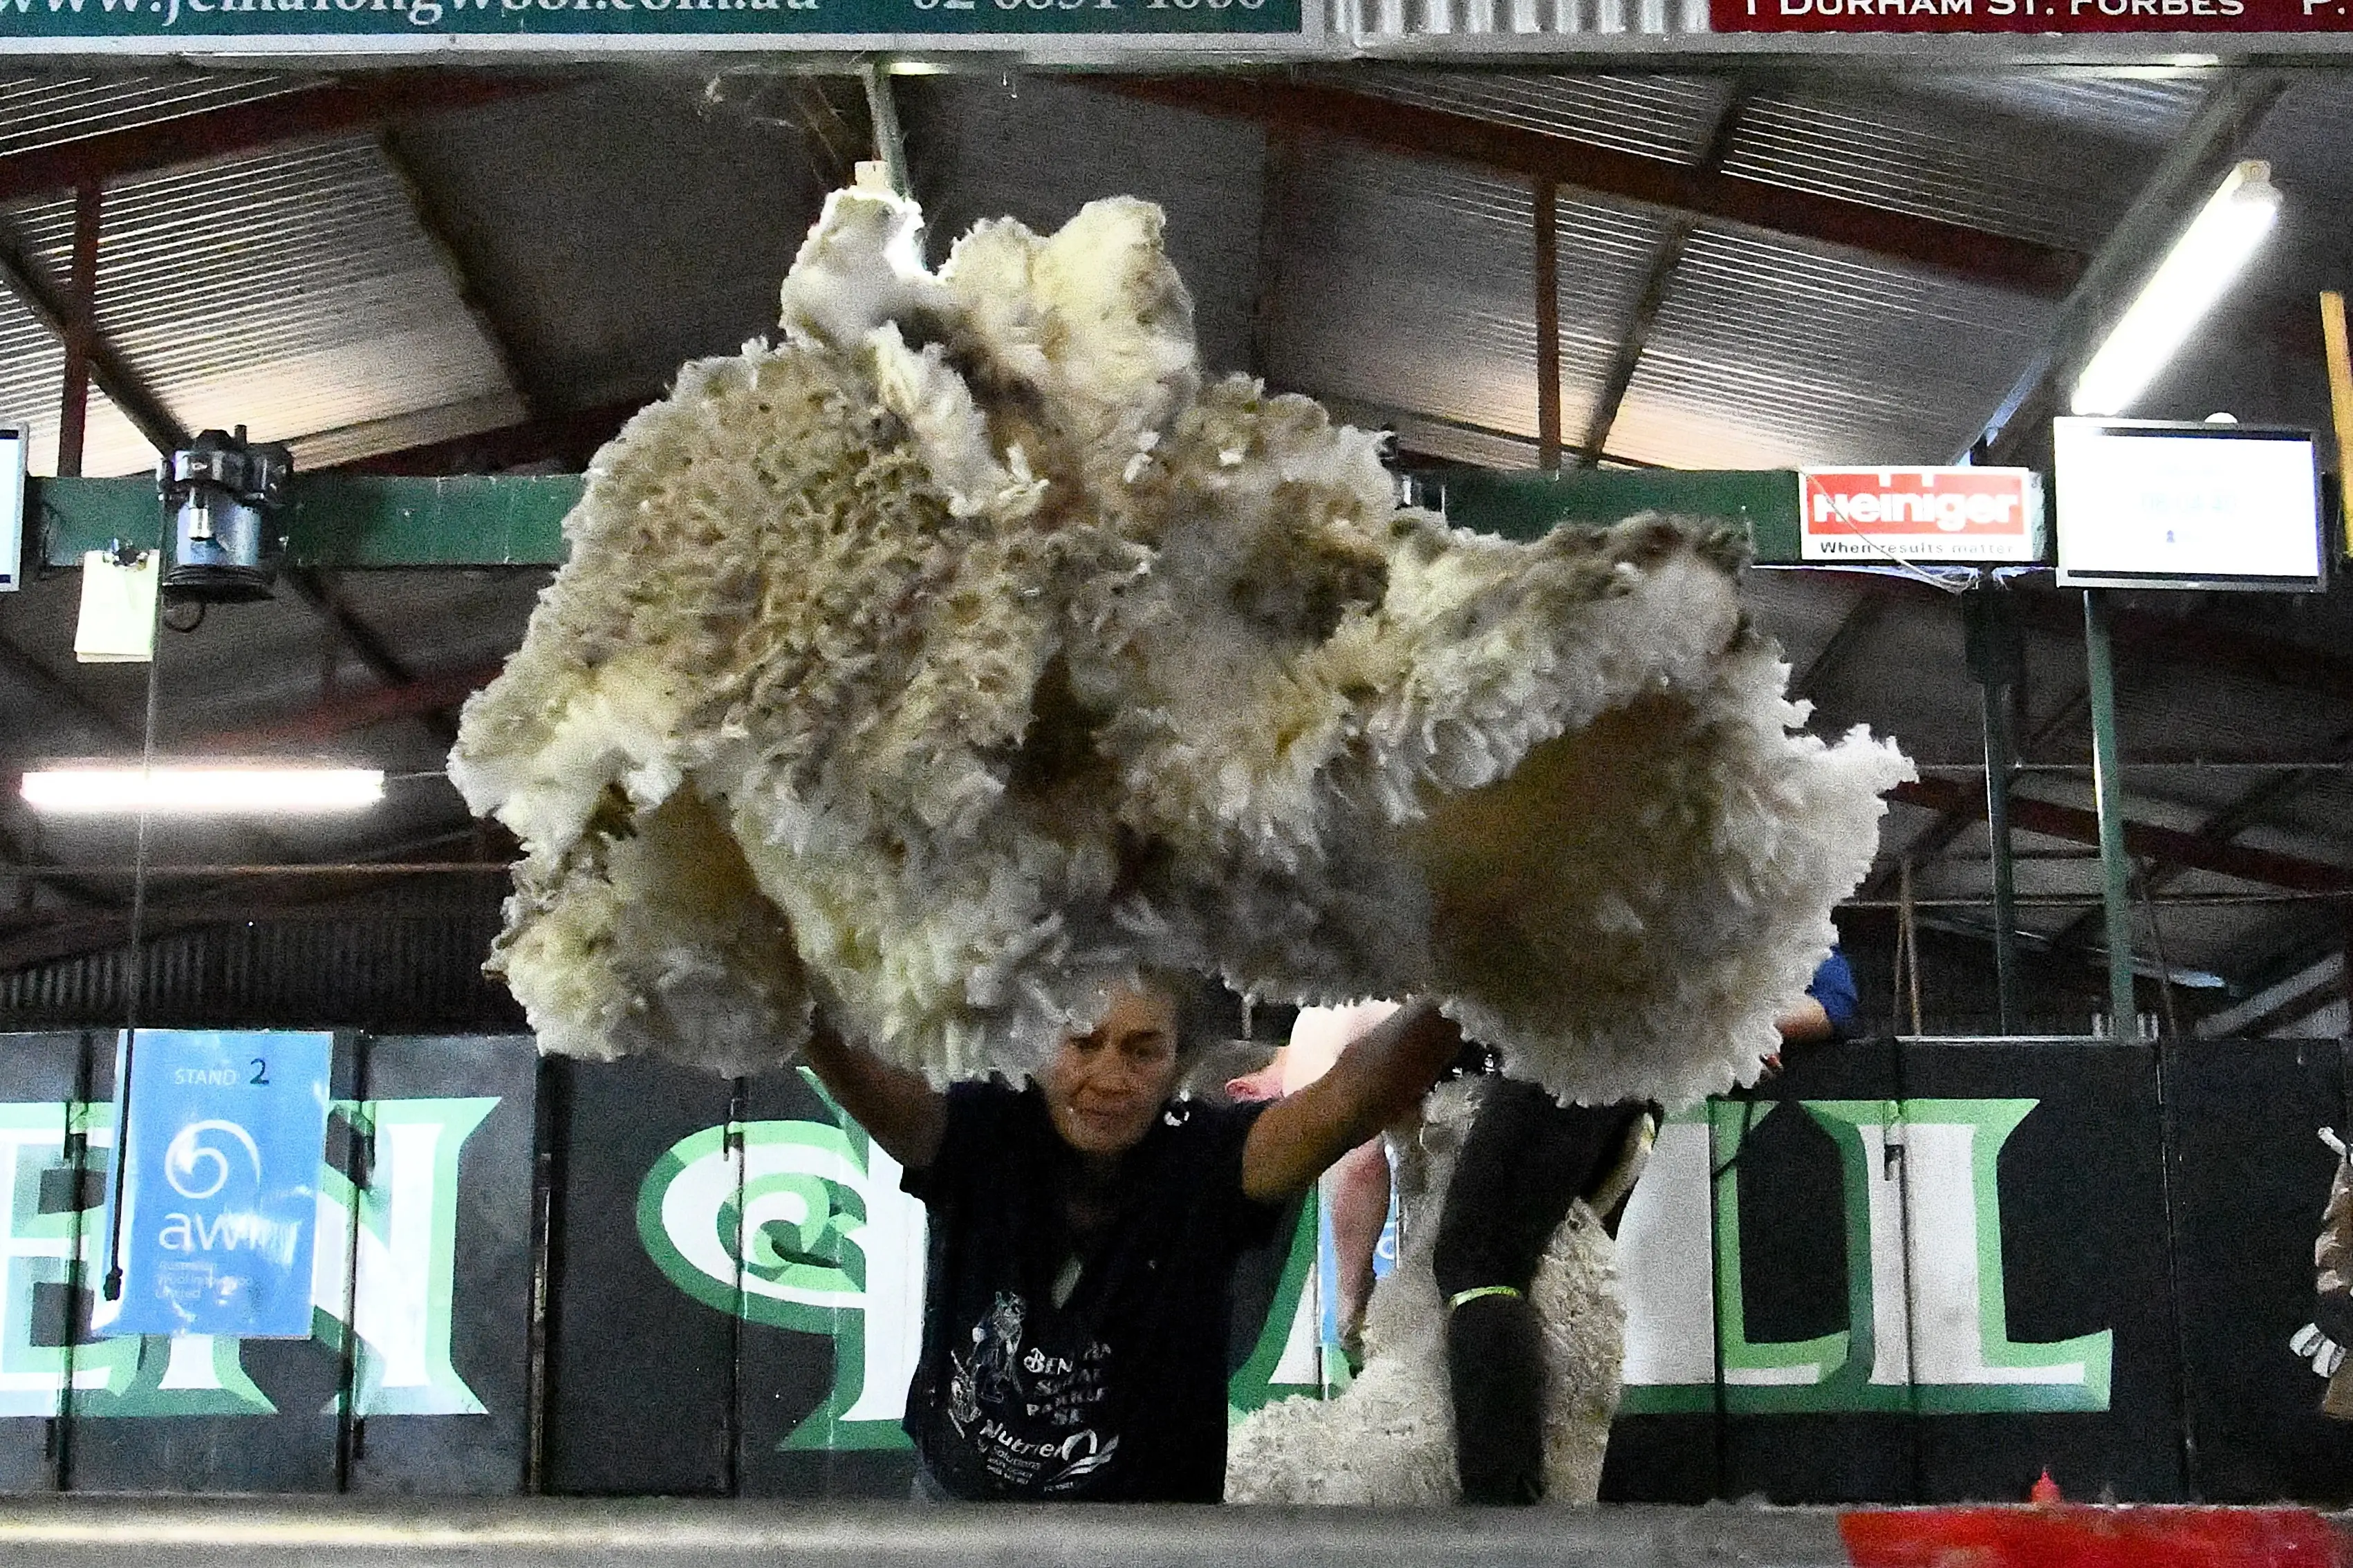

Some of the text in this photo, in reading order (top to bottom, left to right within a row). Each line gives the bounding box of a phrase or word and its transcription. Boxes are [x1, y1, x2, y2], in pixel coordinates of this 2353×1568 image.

[1813, 474, 2018, 532] Heiniger
[1820, 542, 2013, 554] When results matter
[175, 1058, 270, 1085] STAND 2
[1023, 1347, 1072, 1374] BEN
